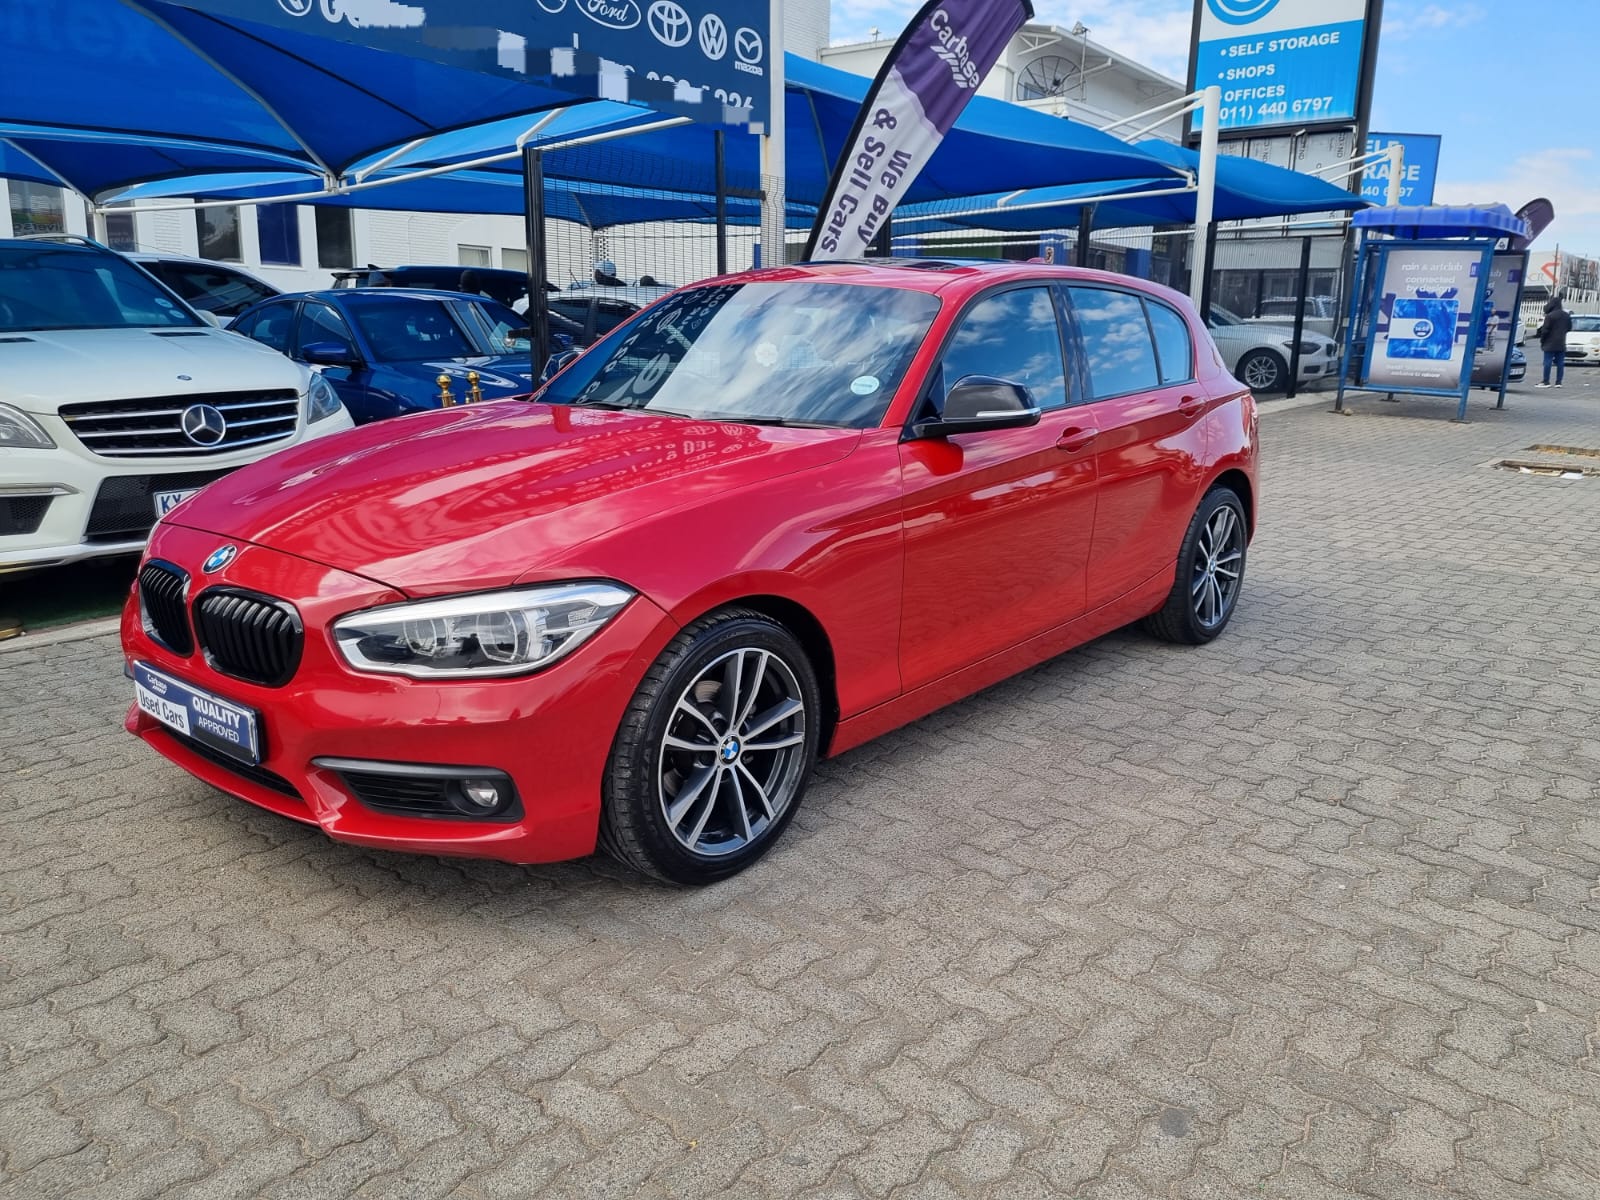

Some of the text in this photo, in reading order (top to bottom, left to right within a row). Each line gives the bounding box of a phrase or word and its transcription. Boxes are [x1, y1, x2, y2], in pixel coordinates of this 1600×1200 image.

[930, 9, 980, 88] Carbase
[1228, 31, 1341, 57] SELF STORAGE
[734, 61, 763, 76] mazda
[1226, 63, 1276, 80] SHOPS
[1224, 84, 1286, 102] OFFICES
[1219, 96, 1333, 120] 011) 440 6797
[821, 108, 898, 253] & Sell Cars
[1360, 186, 1380, 197] 40
[857, 149, 912, 245] We Buy
[139, 688, 185, 729] Used Cars
[192, 696, 241, 729] QUALITY
[198, 715, 240, 743] APPROVED
